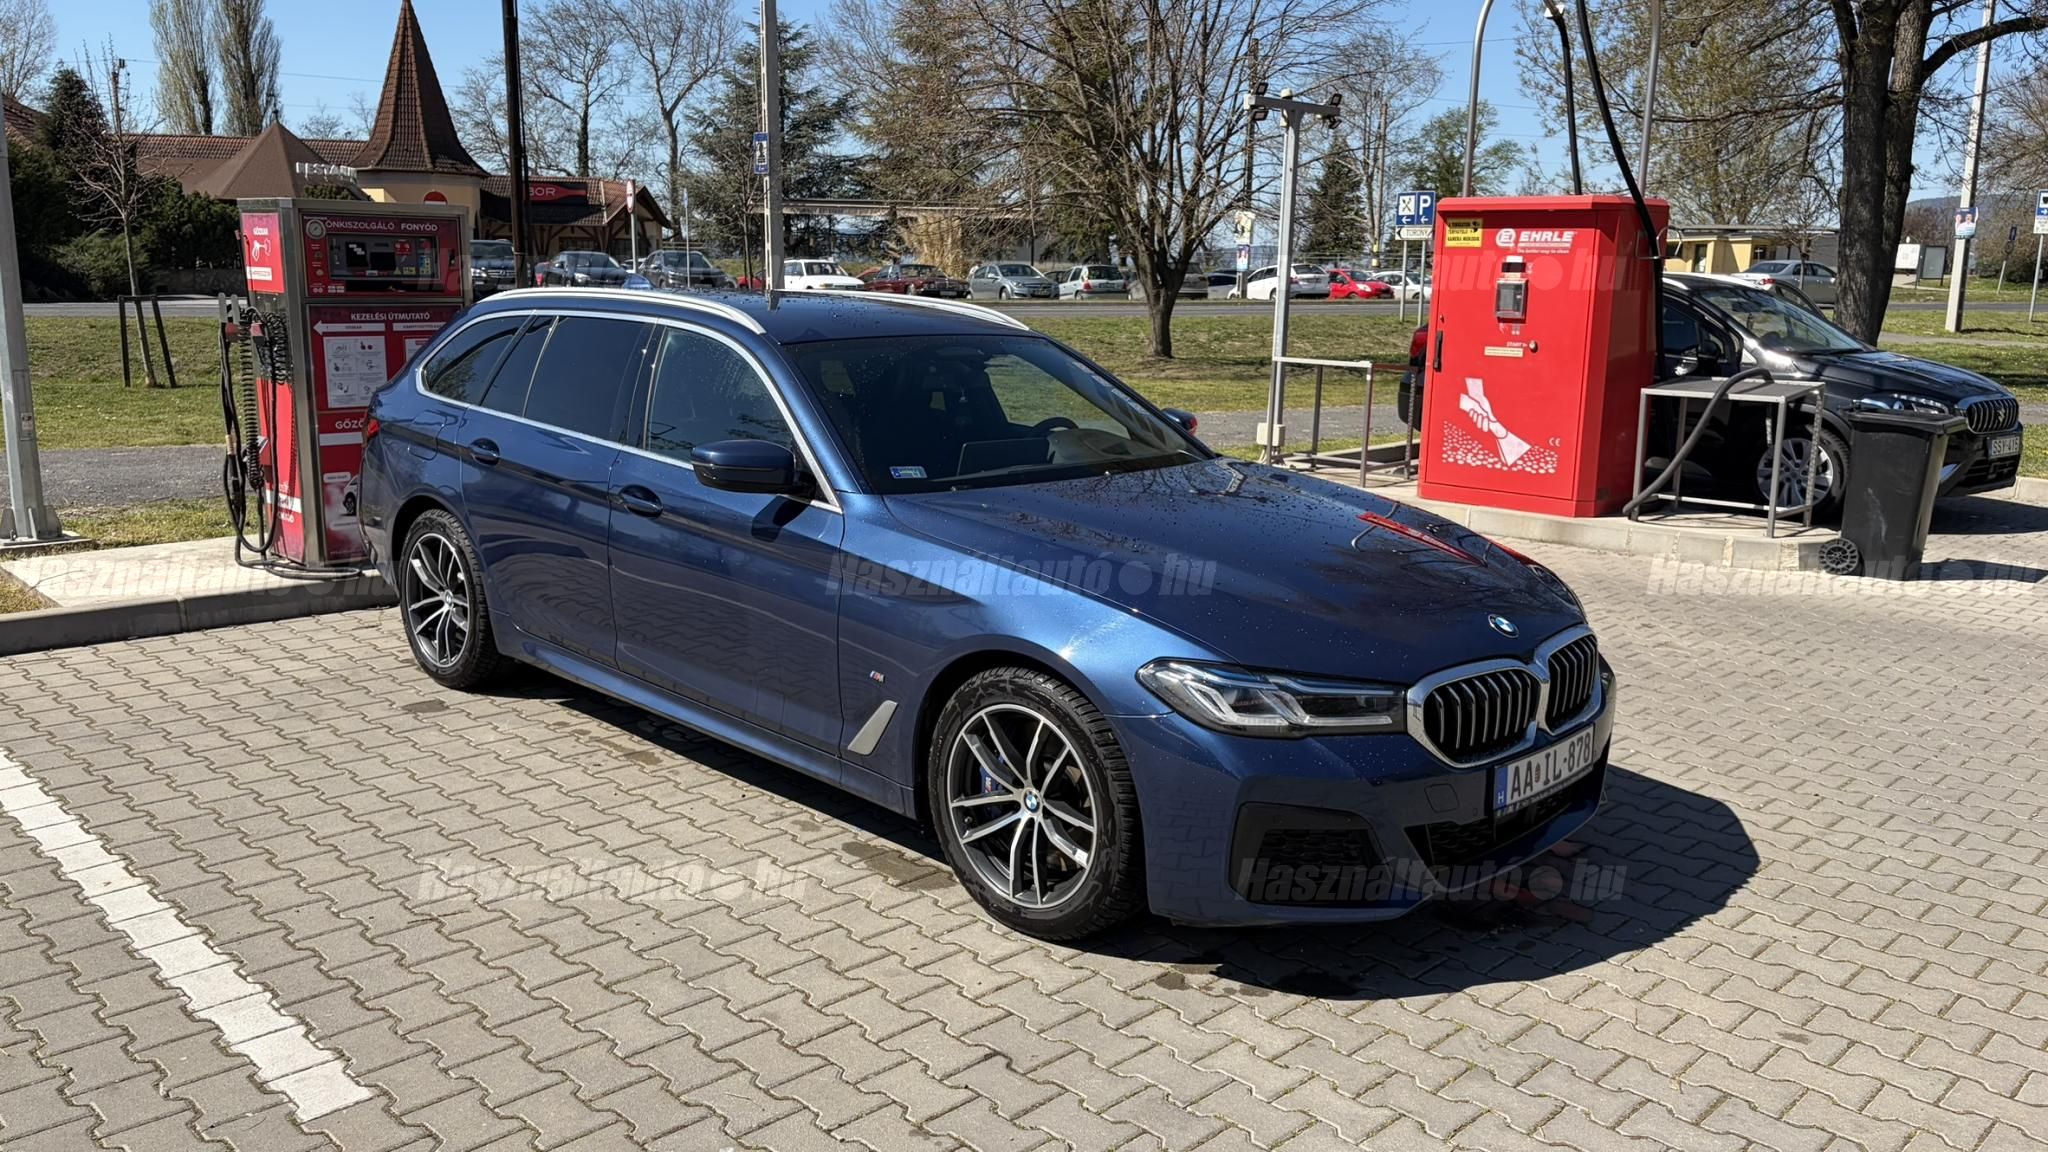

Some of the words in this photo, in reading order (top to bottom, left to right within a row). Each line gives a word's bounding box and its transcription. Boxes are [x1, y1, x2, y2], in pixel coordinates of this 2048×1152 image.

[1419, 195, 1431, 215] P
[401, 221, 438, 231] FONYÓD
[1519, 231, 1574, 242] EHRLE
[350, 312, 387, 321] KEZELÉSI
[1510, 760, 1534, 800] AA
[1497, 791, 1505, 805] H
